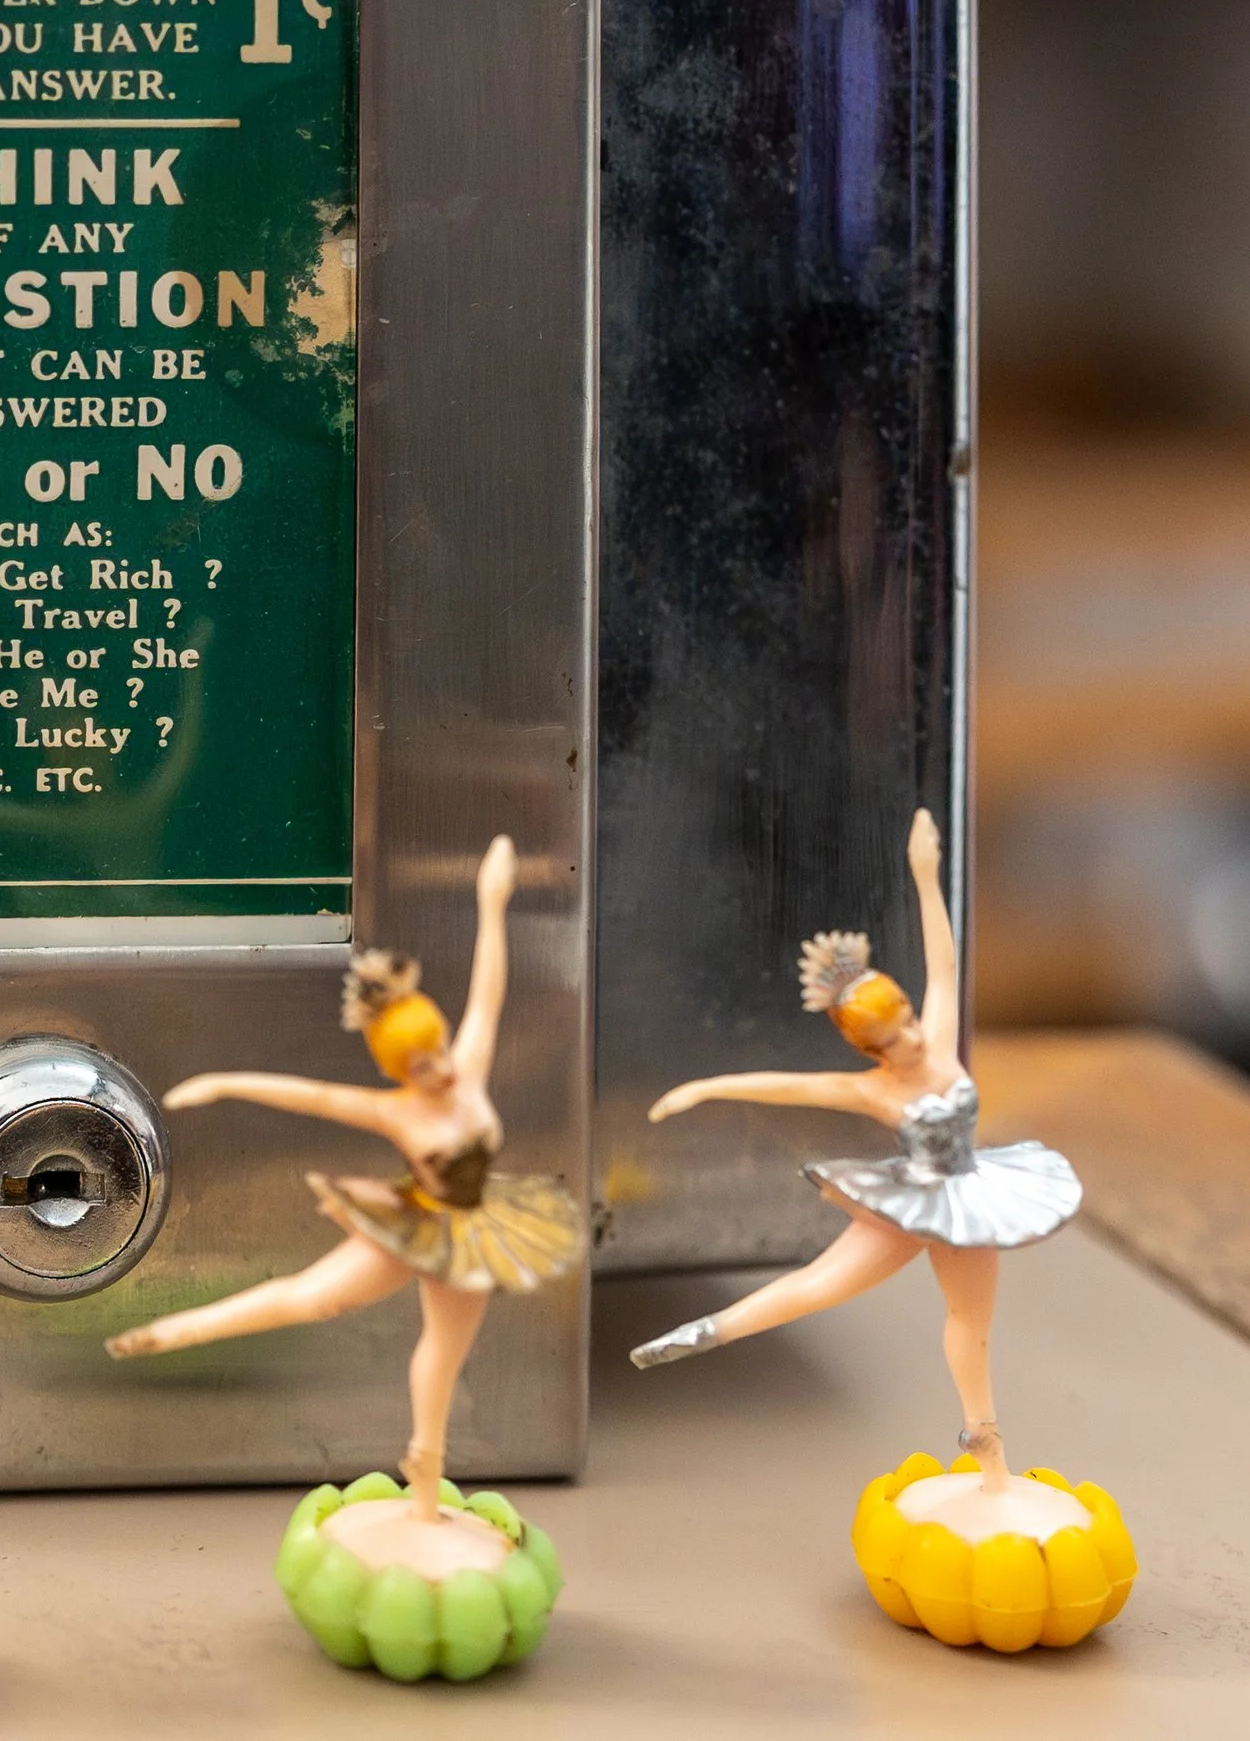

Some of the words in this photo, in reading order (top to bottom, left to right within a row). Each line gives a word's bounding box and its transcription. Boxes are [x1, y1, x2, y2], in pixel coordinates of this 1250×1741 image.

[74, 23, 198, 52] HAVE
[39, 223, 133, 253] ANY
[31, 350, 122, 380] CAN
[153, 350, 206, 379] BE
[25, 461, 99, 502] or
[138, 444, 242, 500] NO
[64, 522, 111, 546] AS:
[90, 559, 172, 589] Rich
[15, 599, 137, 629] Travel
[67, 648, 106, 668] or
[132, 638, 199, 668] She
[41, 678, 98, 707] Me
[16, 718, 130, 754] Lucky
[37, 767, 101, 792] ETC.
